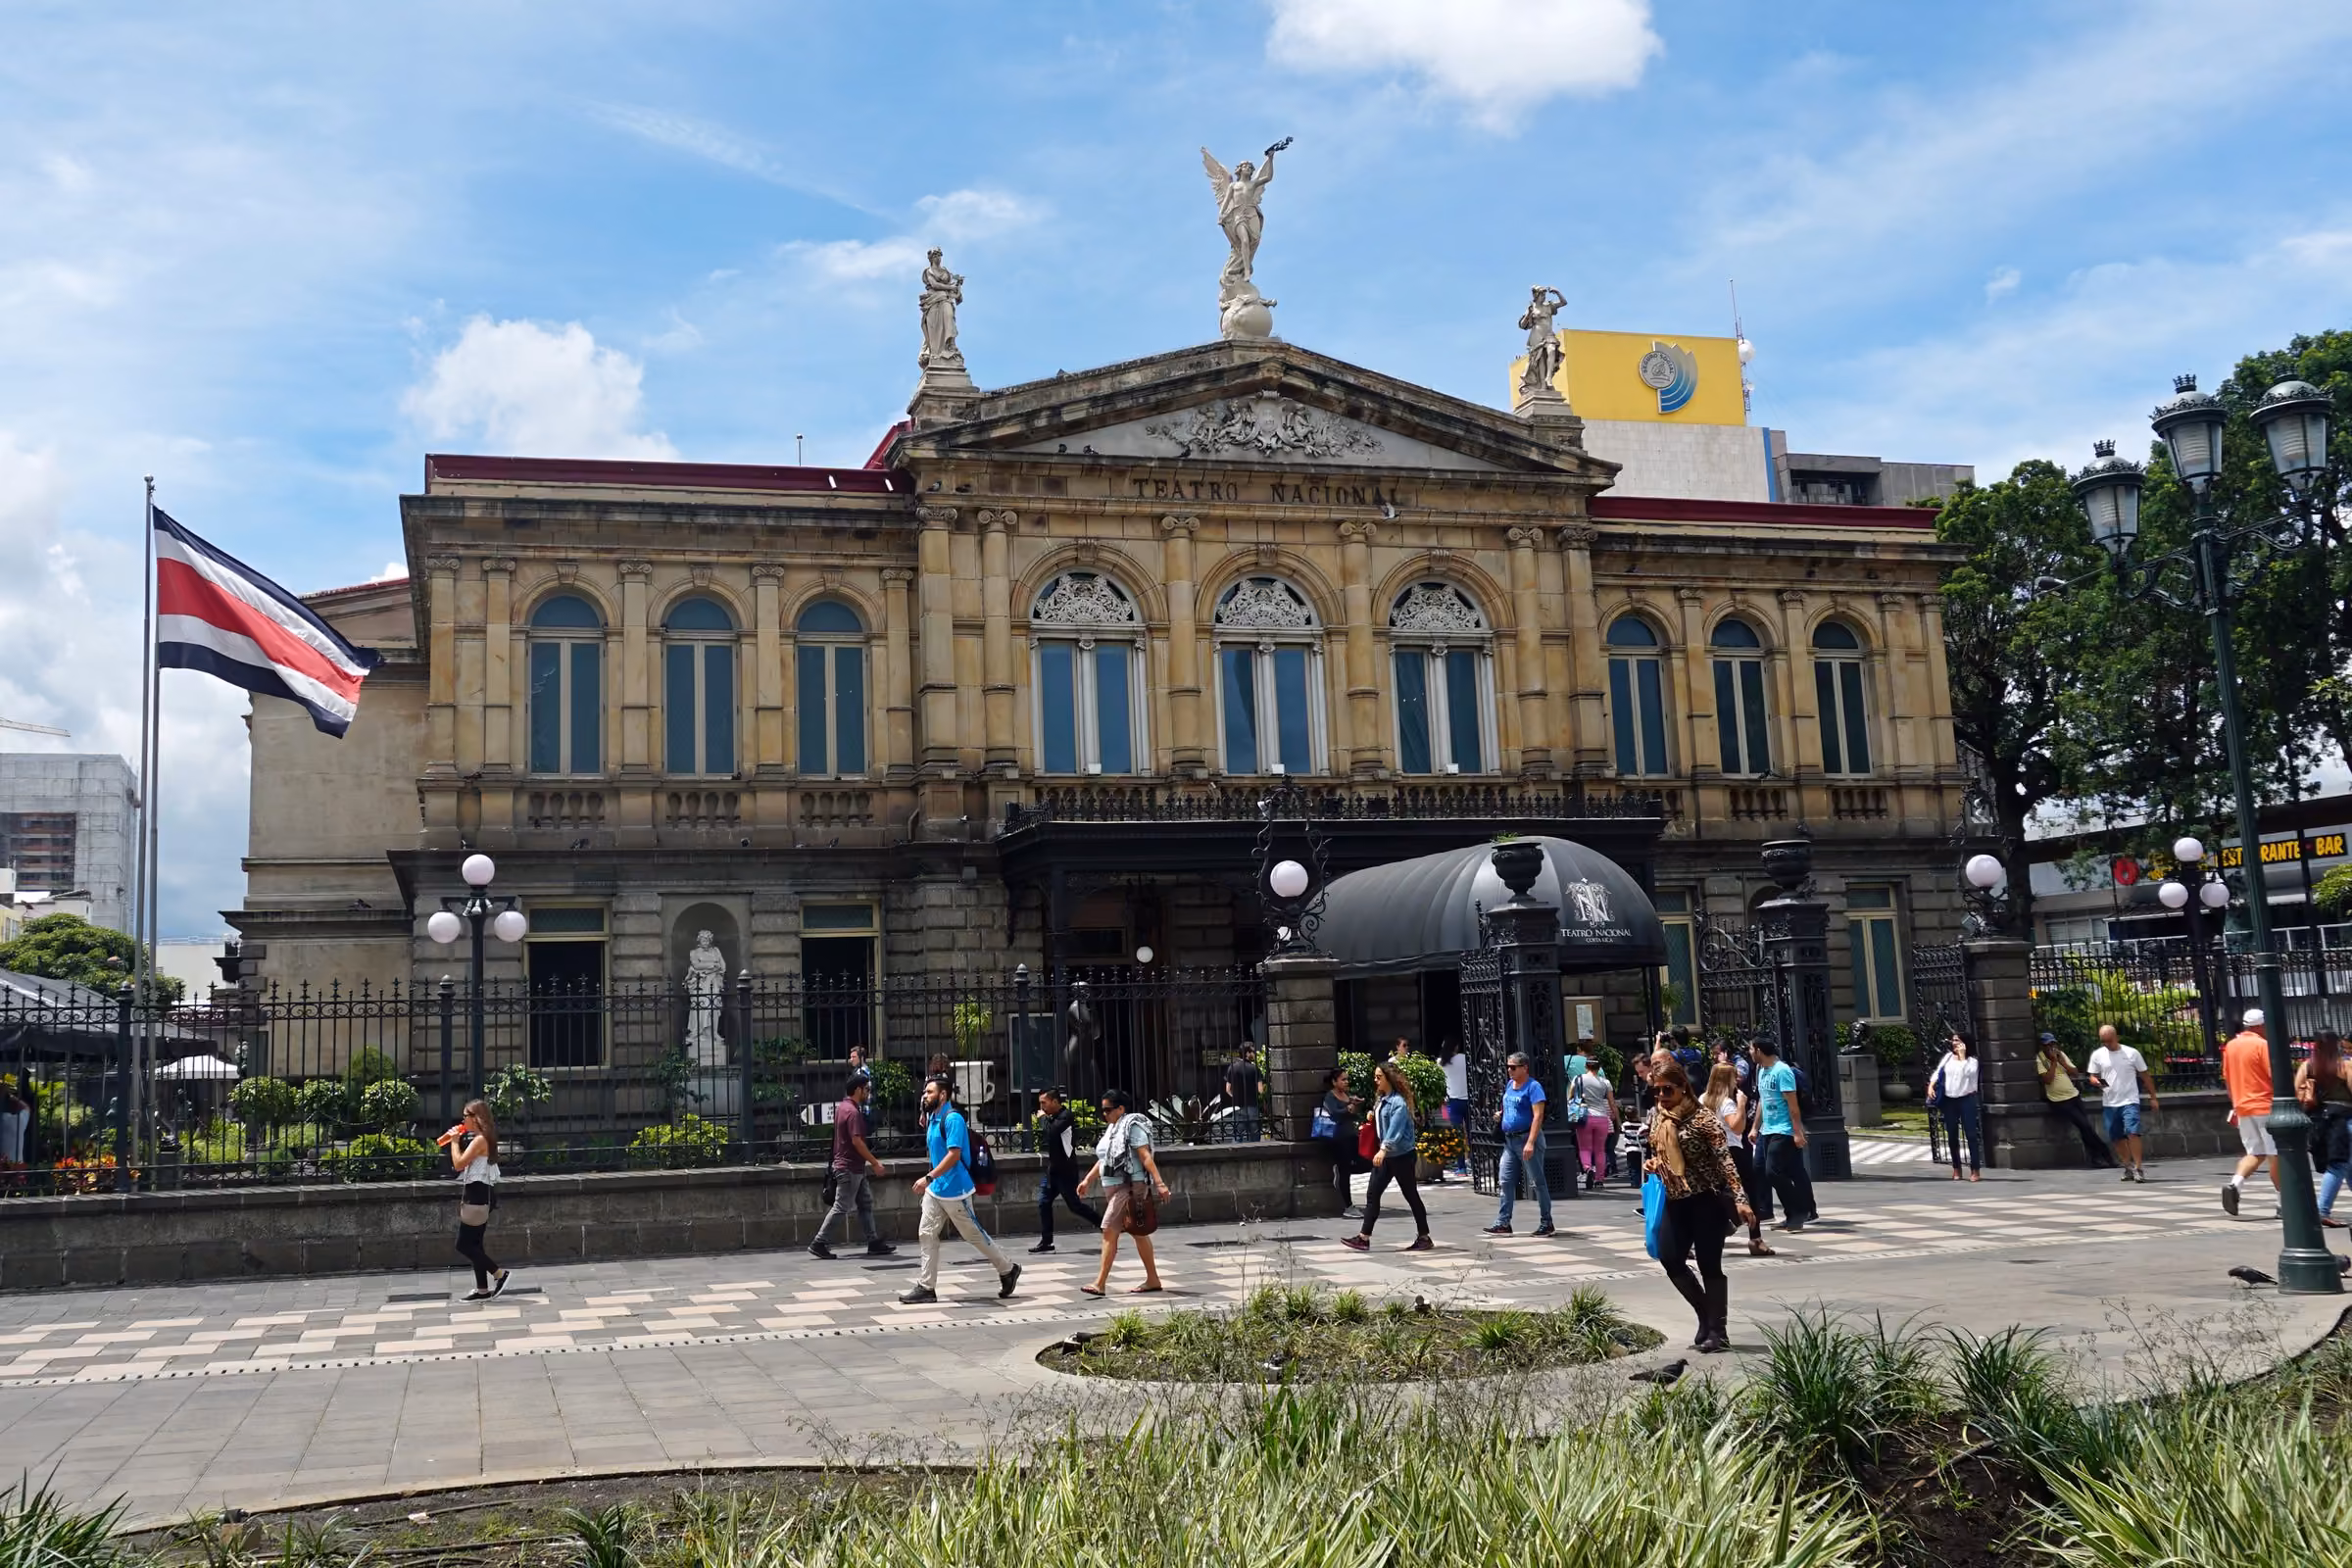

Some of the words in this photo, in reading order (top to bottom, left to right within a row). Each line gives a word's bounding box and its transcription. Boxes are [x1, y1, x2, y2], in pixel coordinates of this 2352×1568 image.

[1642, 353, 1658, 373] SEGURO
[1659, 354, 1675, 373] SOCIAL
[1133, 478, 1238, 501] TEATRO
[1270, 483, 1403, 506] NACIONAL
[2316, 835, 2344, 856] BAR
